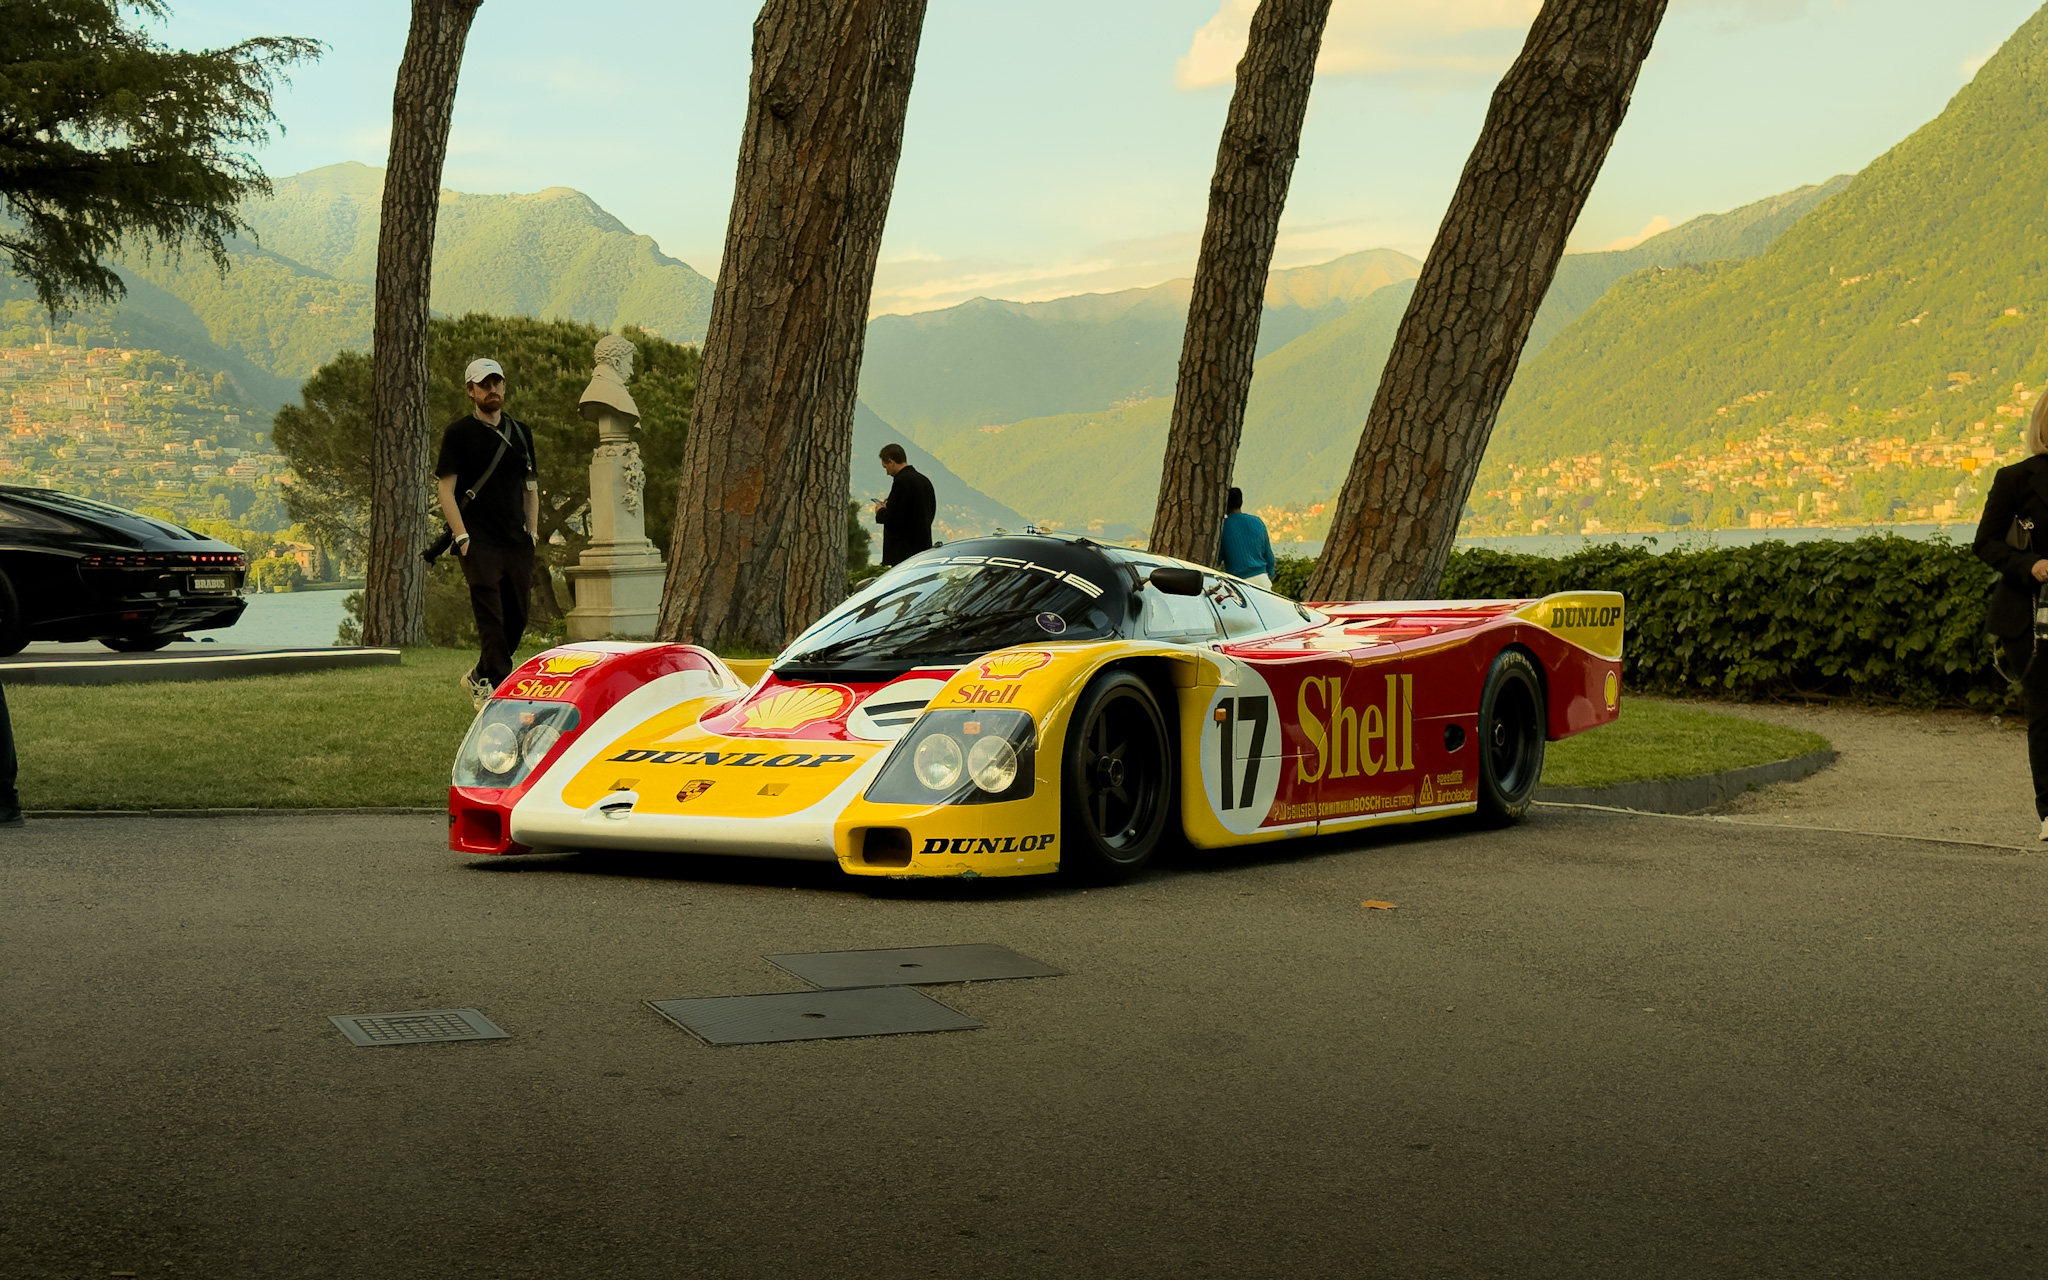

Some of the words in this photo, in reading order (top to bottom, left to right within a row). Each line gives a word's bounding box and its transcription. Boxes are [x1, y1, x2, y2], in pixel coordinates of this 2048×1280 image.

[194, 579, 225, 589] BRABUS
[1551, 607, 1621, 628] DUNLOP
[508, 678, 573, 698] Shell
[950, 684, 1022, 704] Shell
[1297, 673, 1415, 785] Shell
[606, 749, 855, 768] DUNLOP
[1215, 695, 1269, 811] 17
[1436, 788, 1473, 803] Turbolader
[1291, 802, 1318, 819] BILSTEIN
[1354, 795, 1381, 812] BOSCH
[919, 834, 1055, 854] DUNLOP
